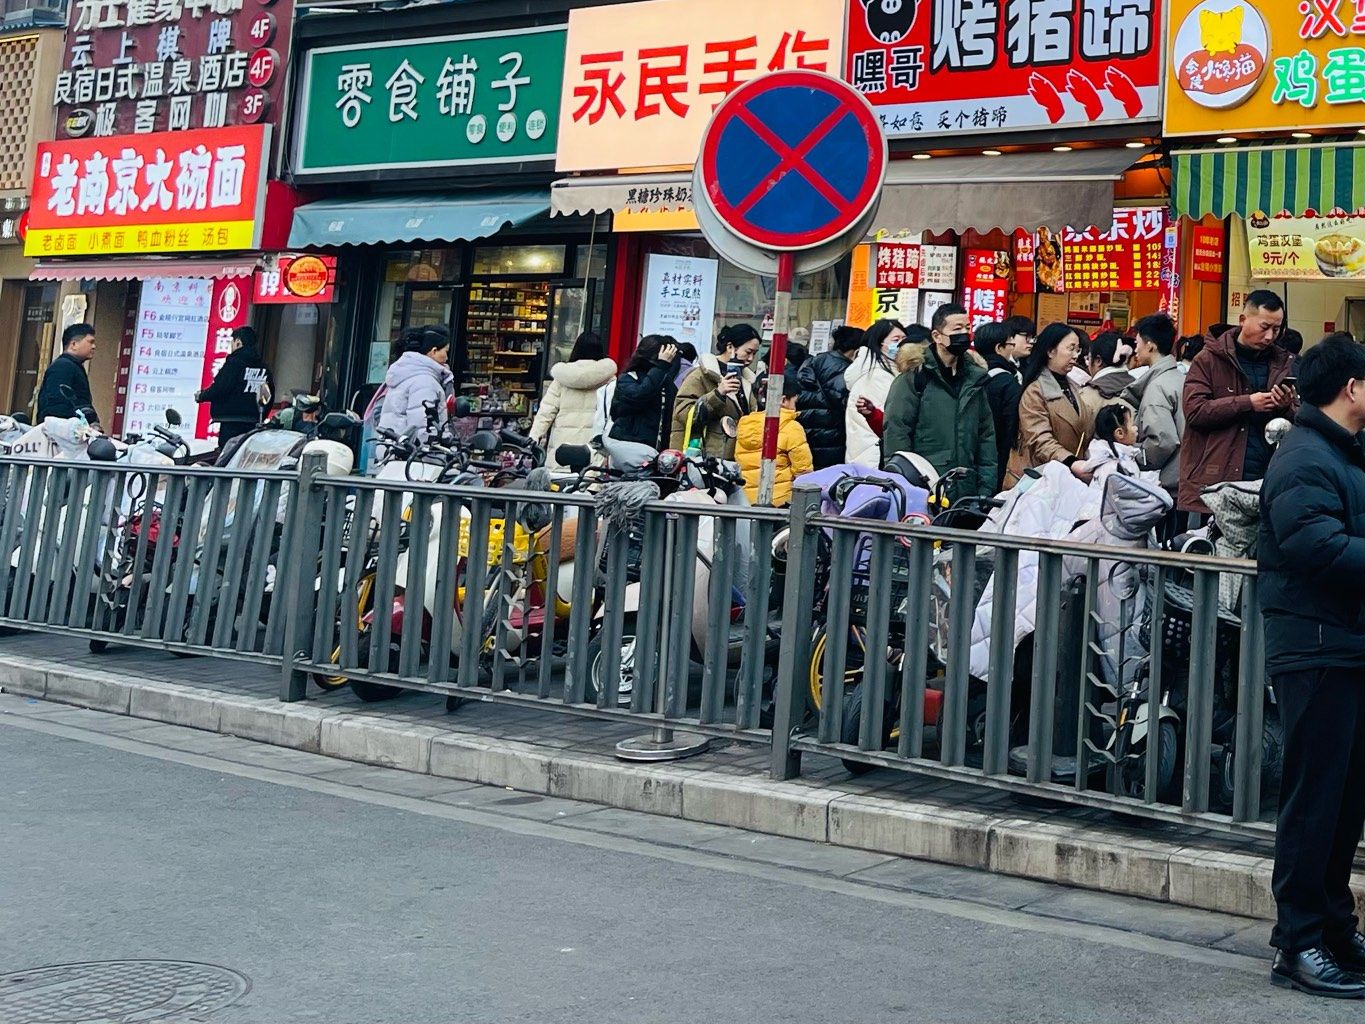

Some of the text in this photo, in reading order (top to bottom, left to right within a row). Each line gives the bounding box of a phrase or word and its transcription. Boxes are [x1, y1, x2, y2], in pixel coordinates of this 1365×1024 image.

[71, 18, 270, 69] 云上棋牌 4F
[53, 51, 272, 107] 良宿日式温泉酒店 4F
[853, 46, 924, 93] 嘿哥
[335, 51, 532, 130] 零食铺子
[93, 93, 229, 137] 极客网咖
[243, 96, 264, 114] 3F
[936, 105, 1008, 129] 买个猪蹄
[47, 143, 247, 217] 老南京大碗面
[42, 227, 229, 251] 老卤面 小煮面 鸭血粉丝 汤包
[1257, 234, 1303, 247] 鸡蛋汉堡
[878, 247, 919, 269] 烤猪蹄
[1263, 251, 1300, 265] 9元/个
[878, 271, 914, 285] 立等可取
[876, 287, 901, 313] 京
[143, 310, 157, 321] F6
[141, 328, 154, 339] F5
[139, 346, 152, 357] F4
[137, 364, 150, 375] F4
[134, 383, 147, 394] F3
[132, 401, 145, 412] F3
